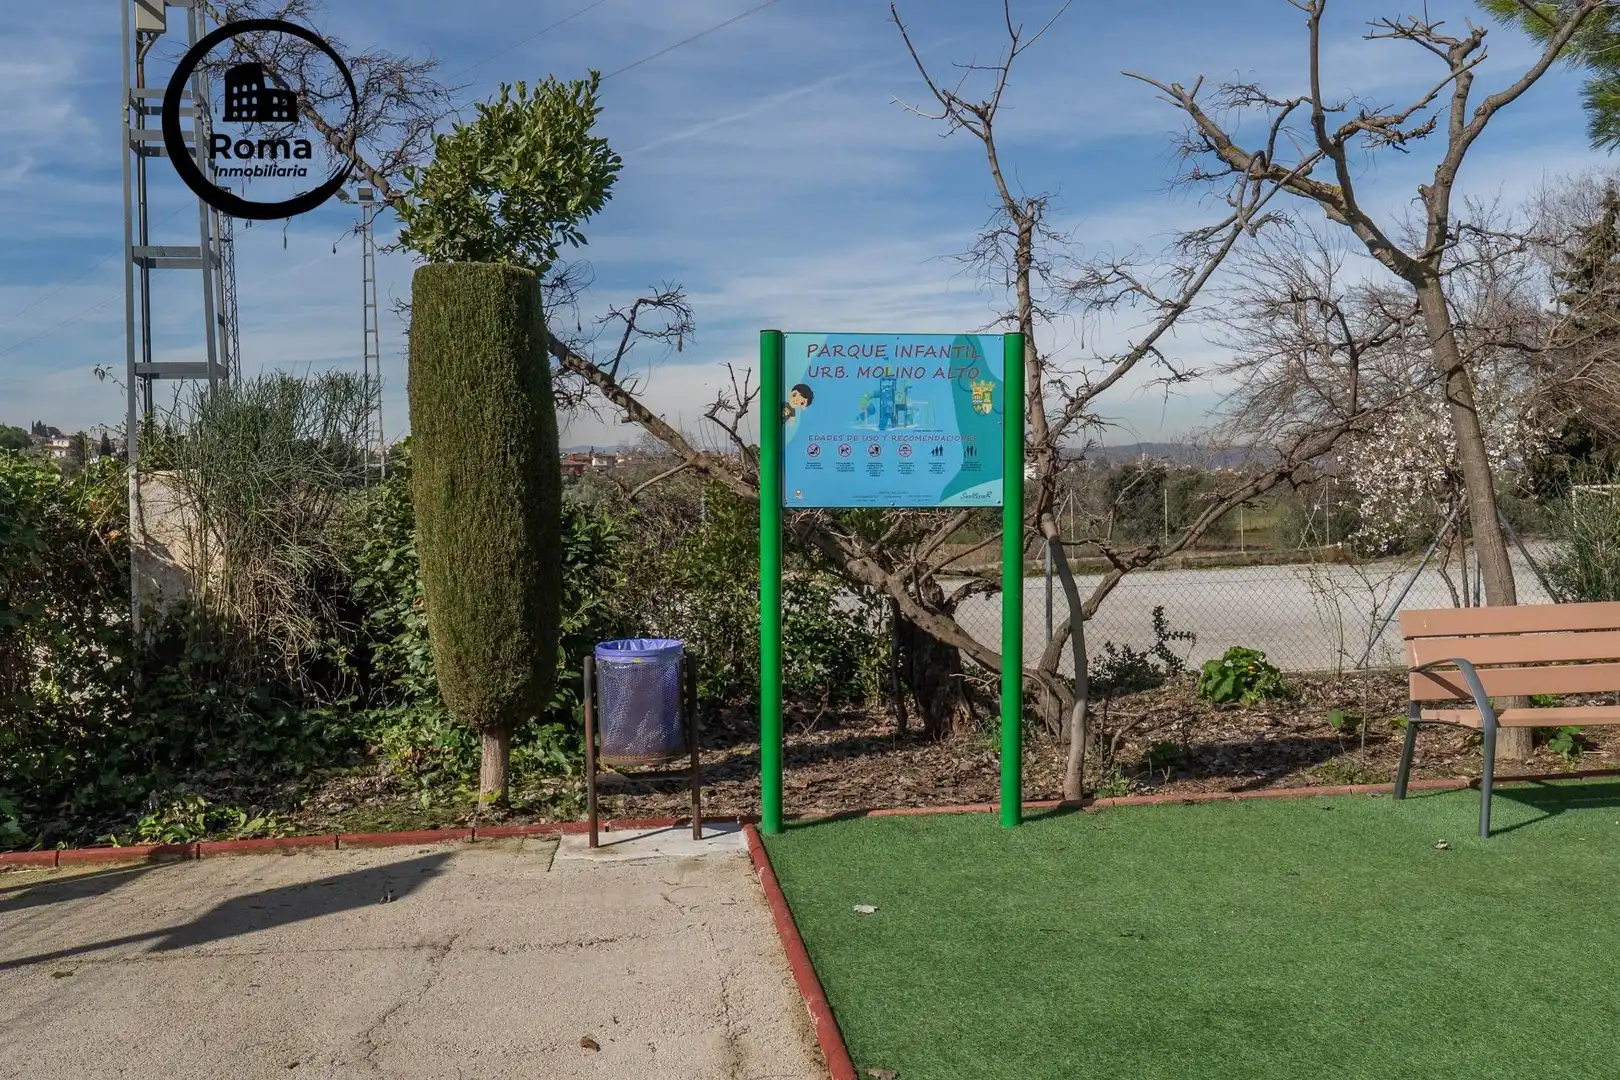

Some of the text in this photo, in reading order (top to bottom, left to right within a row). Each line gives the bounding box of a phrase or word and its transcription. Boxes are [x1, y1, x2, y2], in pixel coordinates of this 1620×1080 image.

[806, 343, 982, 360] PARQUE INFANTIL
[807, 365, 980, 380] URB. MOLINO ALTO
[808, 434, 977, 442] EDADES DE USO Y RECOMENDACIONES
